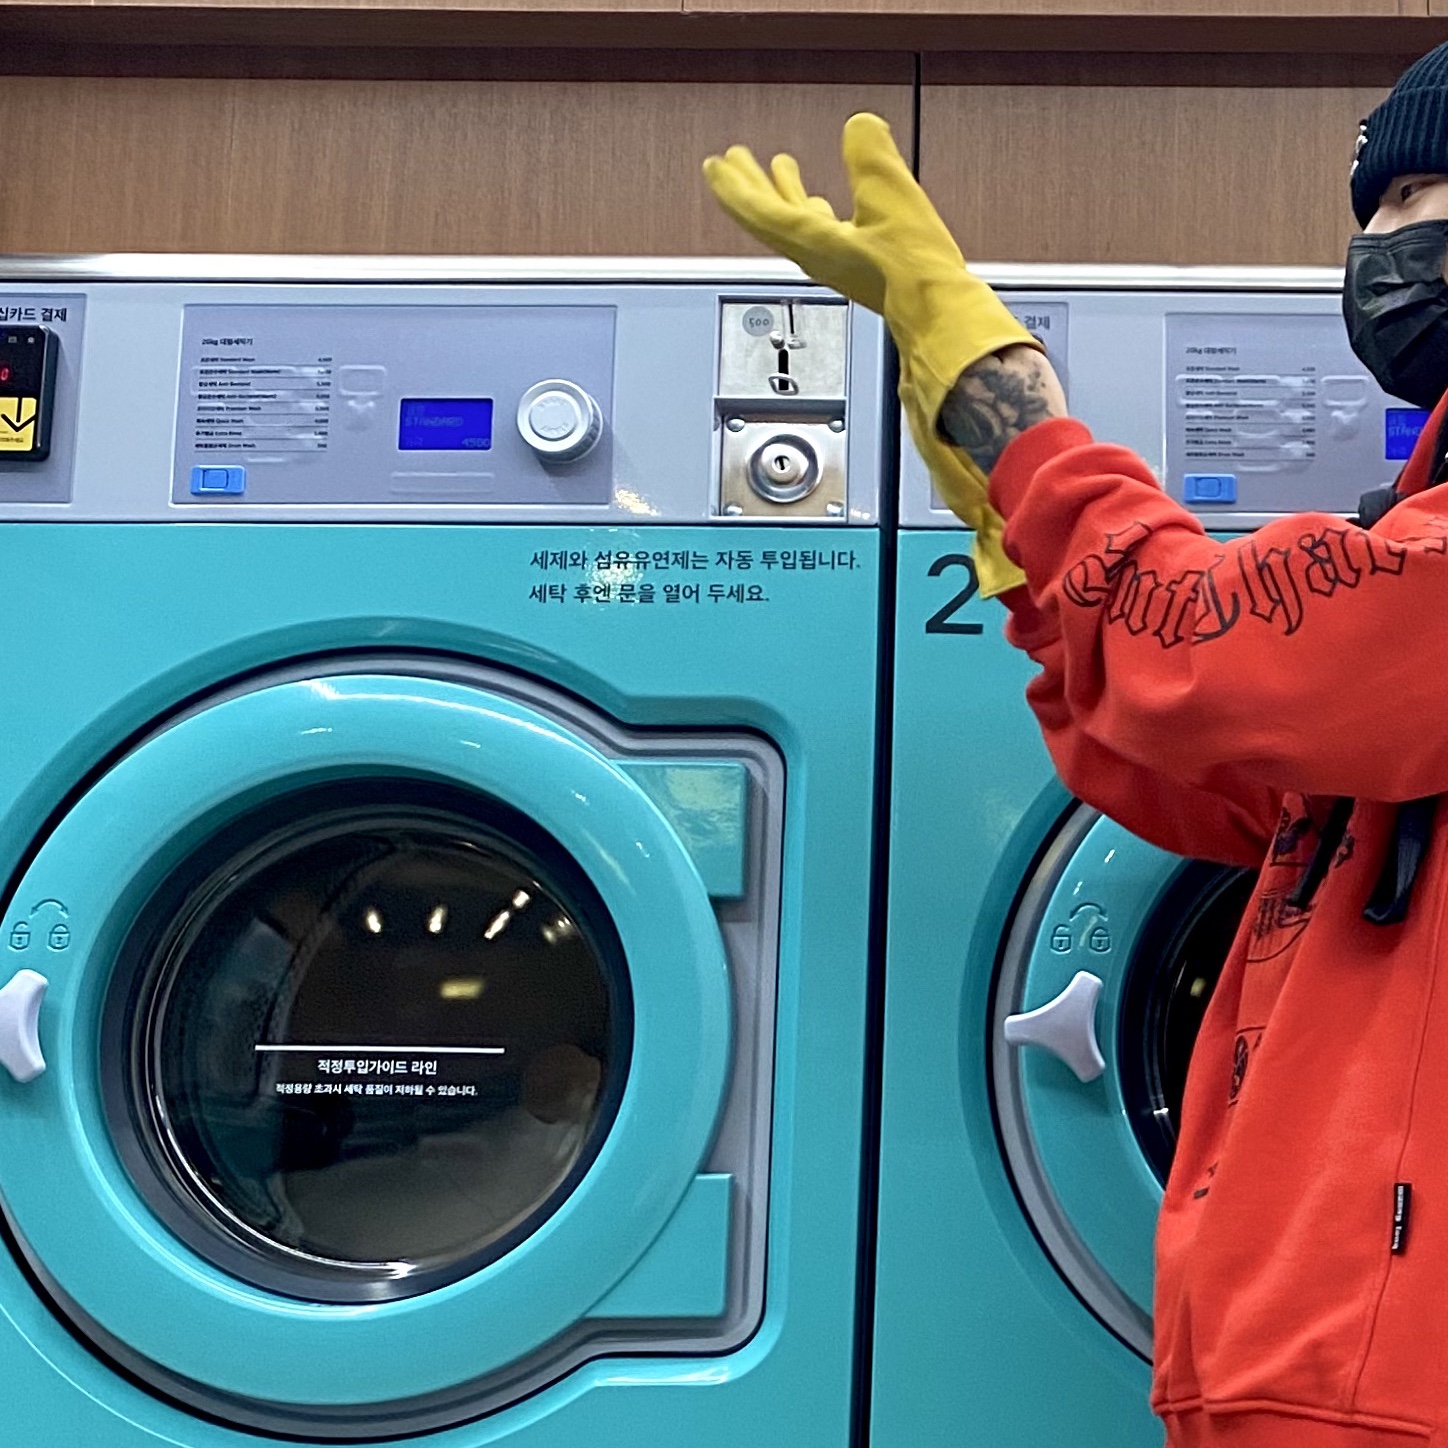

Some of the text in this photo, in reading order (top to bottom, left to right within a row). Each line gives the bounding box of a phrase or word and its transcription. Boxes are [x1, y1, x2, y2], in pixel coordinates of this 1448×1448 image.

[41, 307, 67, 322] 결제
[749, 317, 770, 328] 500
[1024, 316, 1050, 330] 결제
[530, 550, 861, 570] 세제와 섬유유연제는 자동 투입됩니다.
[529, 584, 770, 603] 세탁 후엔 문을 열어 두세요.
[926, 554, 983, 634] 2
[318, 1059, 437, 1075] 적정투입가이드 라인
[276, 1083, 312, 1095] 적정용량
[314, 1084, 342, 1095] 초과시
[344, 1084, 362, 1095] 세탁
[365, 1085, 393, 1096] 품질이
[426, 1086, 435, 1096] 수
[438, 1085, 478, 1096] 있습니다.
